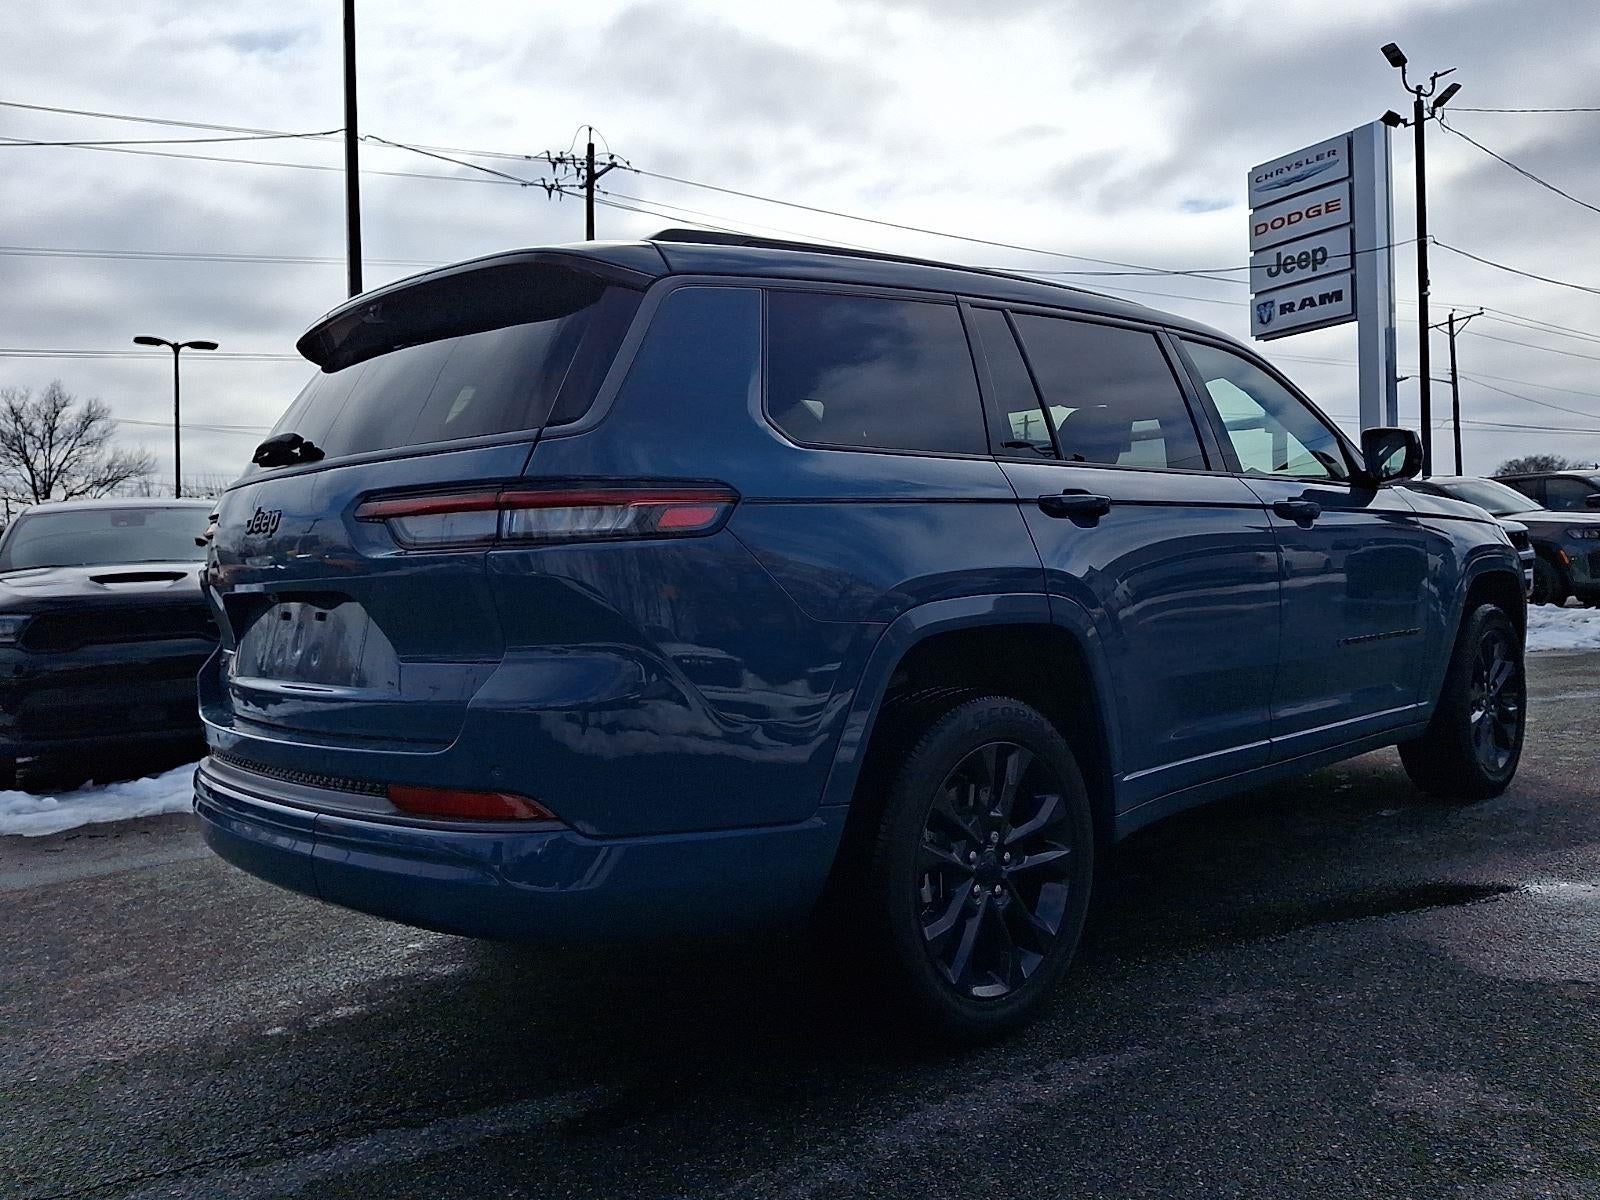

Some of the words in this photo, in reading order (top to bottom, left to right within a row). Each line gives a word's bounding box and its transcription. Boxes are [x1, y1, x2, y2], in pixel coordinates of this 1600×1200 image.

[1255, 149, 1337, 183] CHRYSLER
[1254, 198, 1342, 237] DODGE
[1266, 246, 1328, 278] Jeep
[1279, 289, 1343, 316] RAM
[245, 506, 282, 538] Jeep
